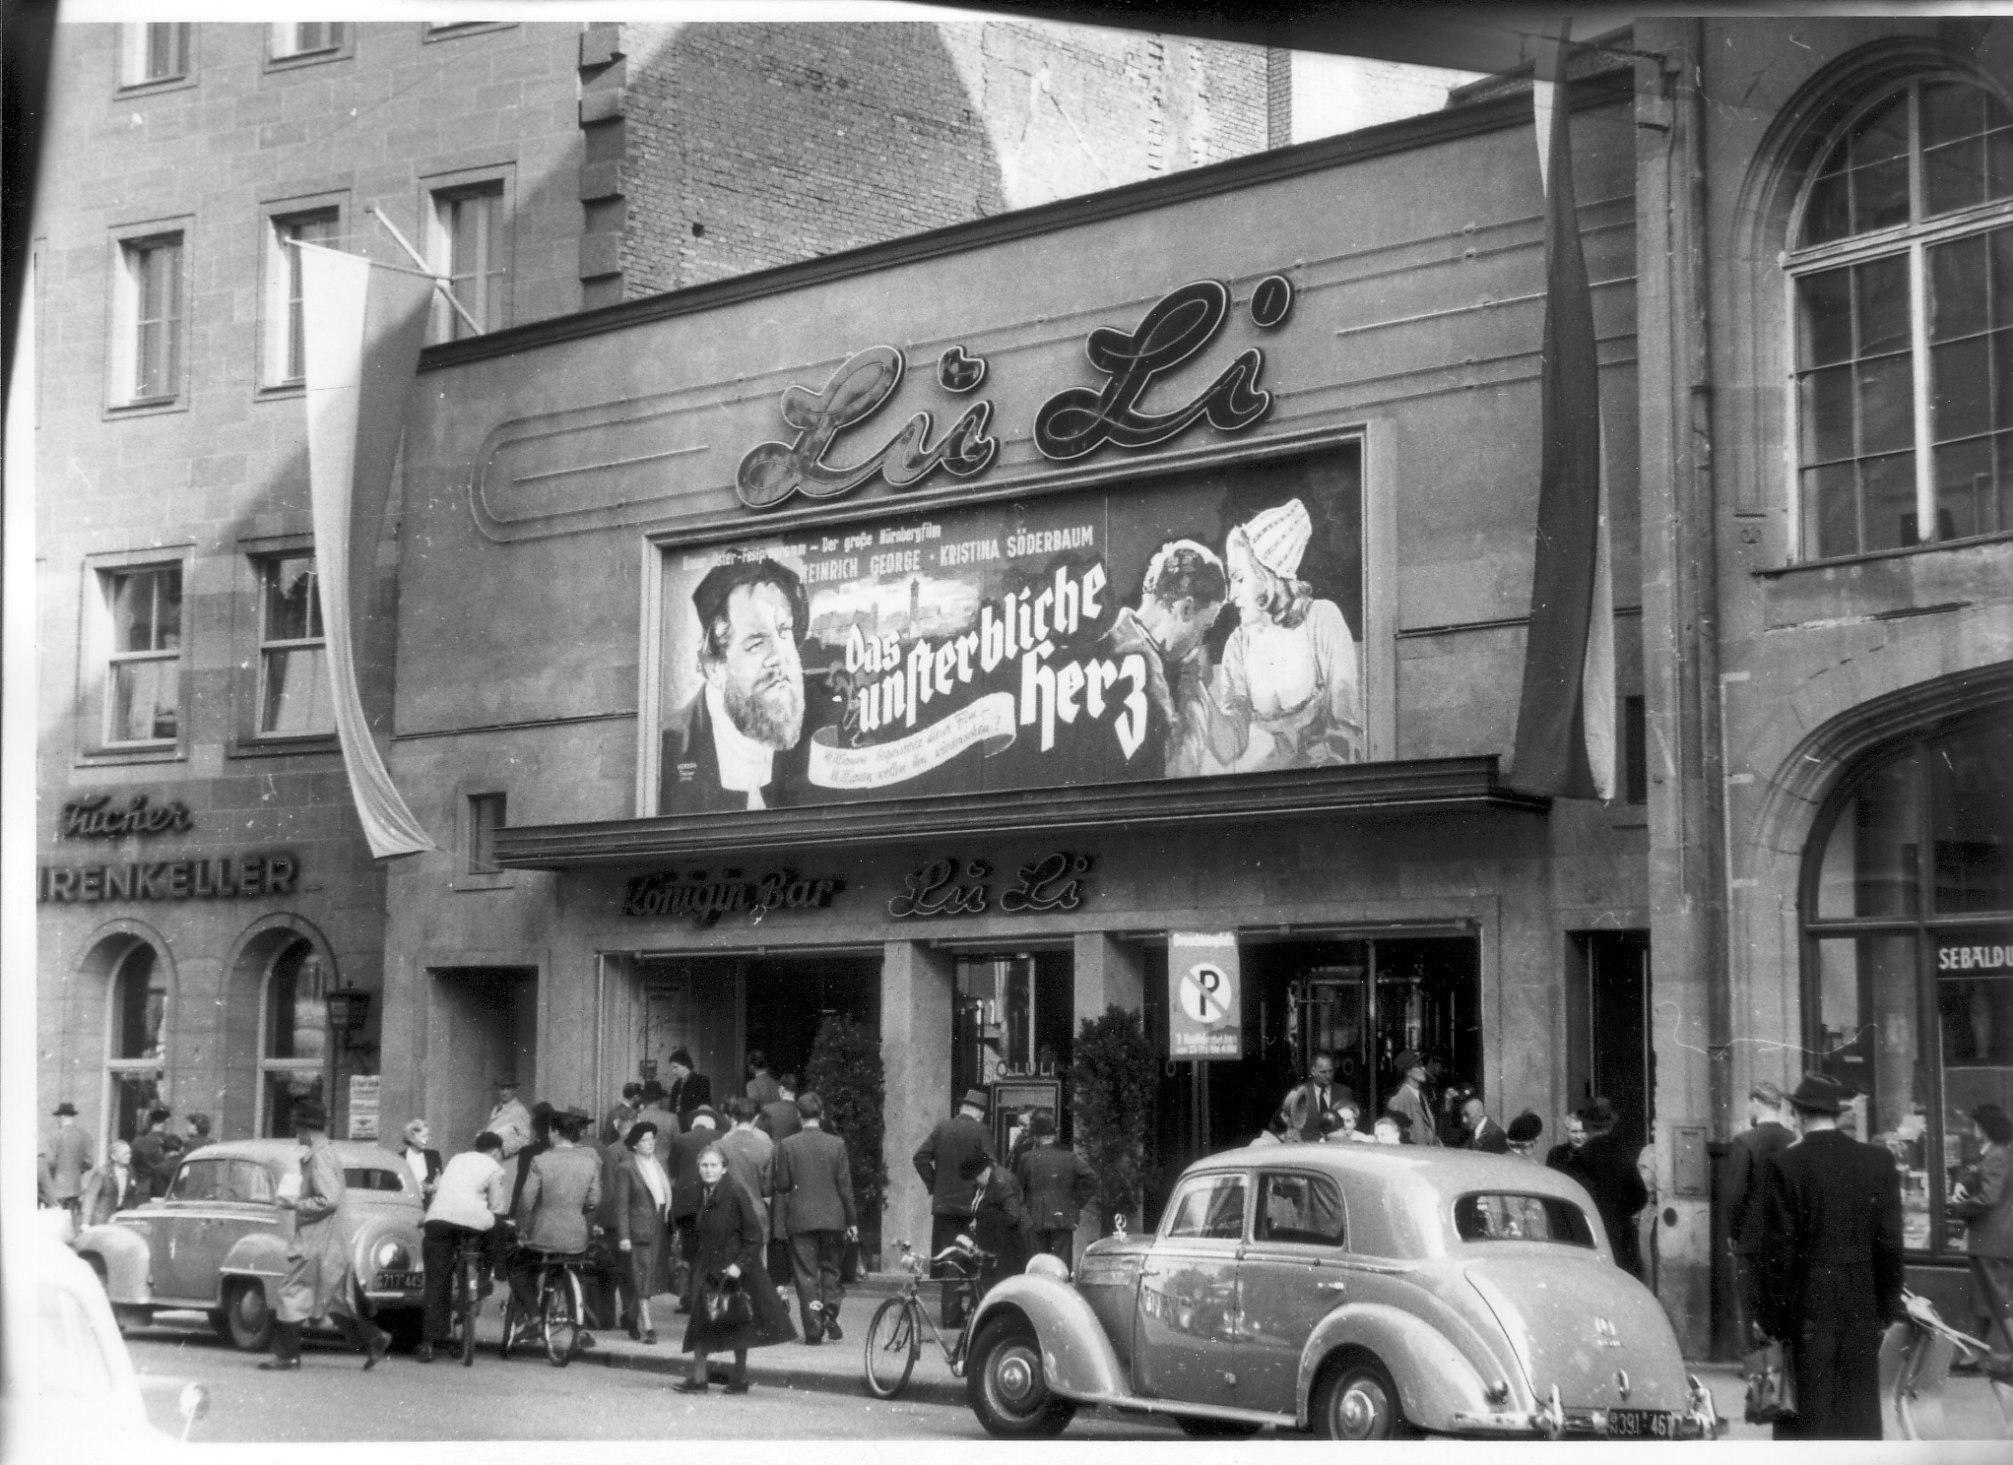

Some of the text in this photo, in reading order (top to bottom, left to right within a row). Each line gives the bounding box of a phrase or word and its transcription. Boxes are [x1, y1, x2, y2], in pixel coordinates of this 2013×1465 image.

[1034, 274, 1293, 460] Li
[799, 525, 1094, 584] HEINRICH GEORGE KRISTINA SÖDERBAUM
[822, 537, 840, 552] Der
[844, 531, 873, 552] große
[845, 623, 901, 673] Das
[64, 795, 193, 838] Tucher
[759, 869, 846, 910] Bar
[1000, 853, 1089, 911] Li
[1200, 969, 1220, 1016] P
